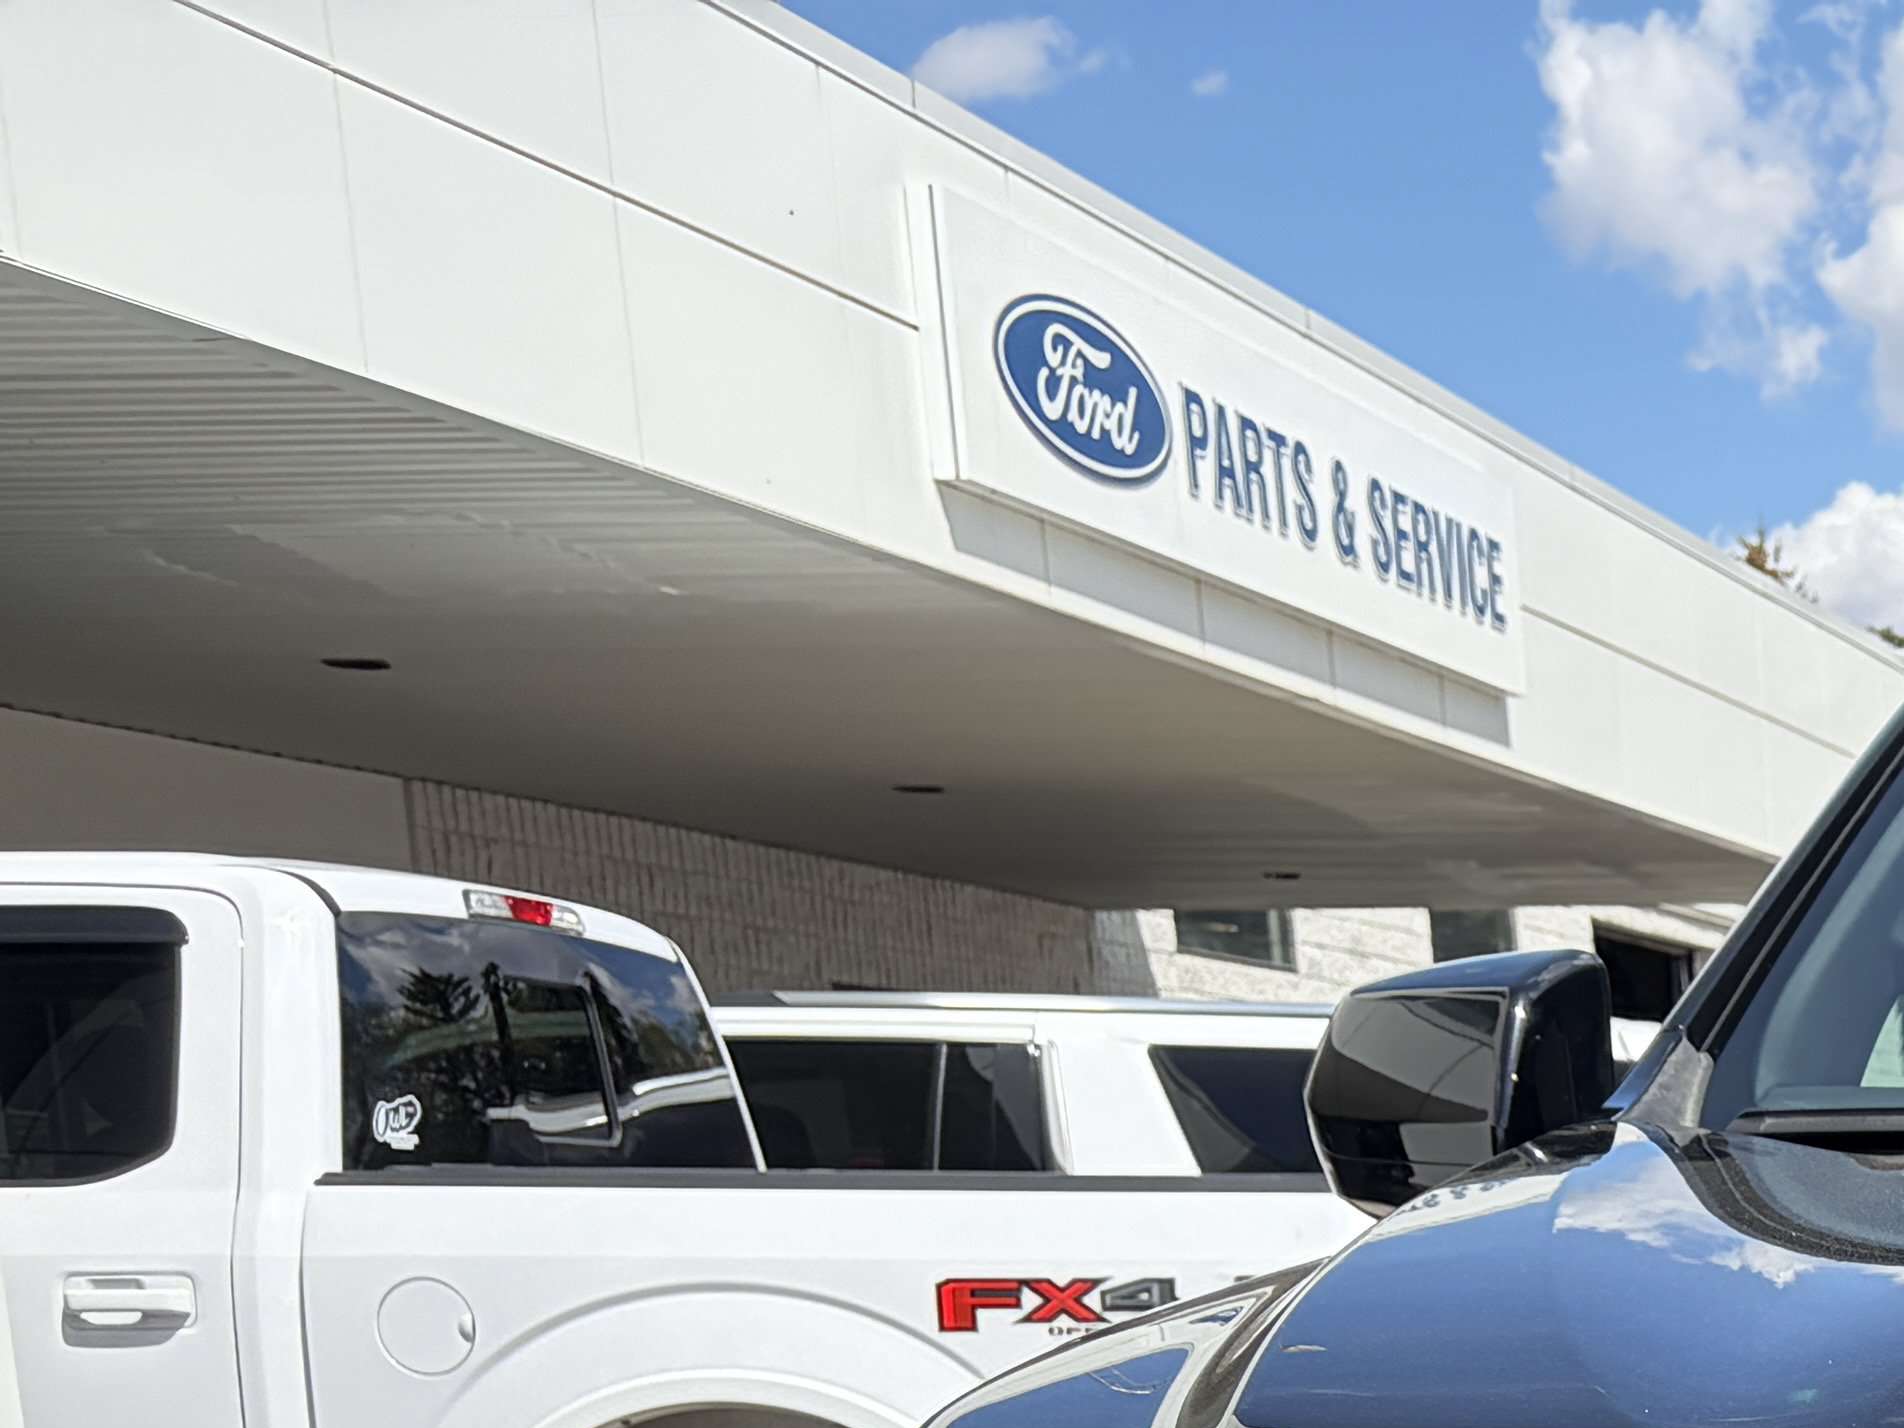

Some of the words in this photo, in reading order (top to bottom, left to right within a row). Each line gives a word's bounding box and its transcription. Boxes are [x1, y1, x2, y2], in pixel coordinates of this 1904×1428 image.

[1037, 323, 1140, 456] Ford
[1180, 382, 1318, 551] PARTS
[1330, 457, 1359, 566] &
[1367, 476, 1508, 633] SERVICE
[935, 1277, 1180, 1332] FX4
